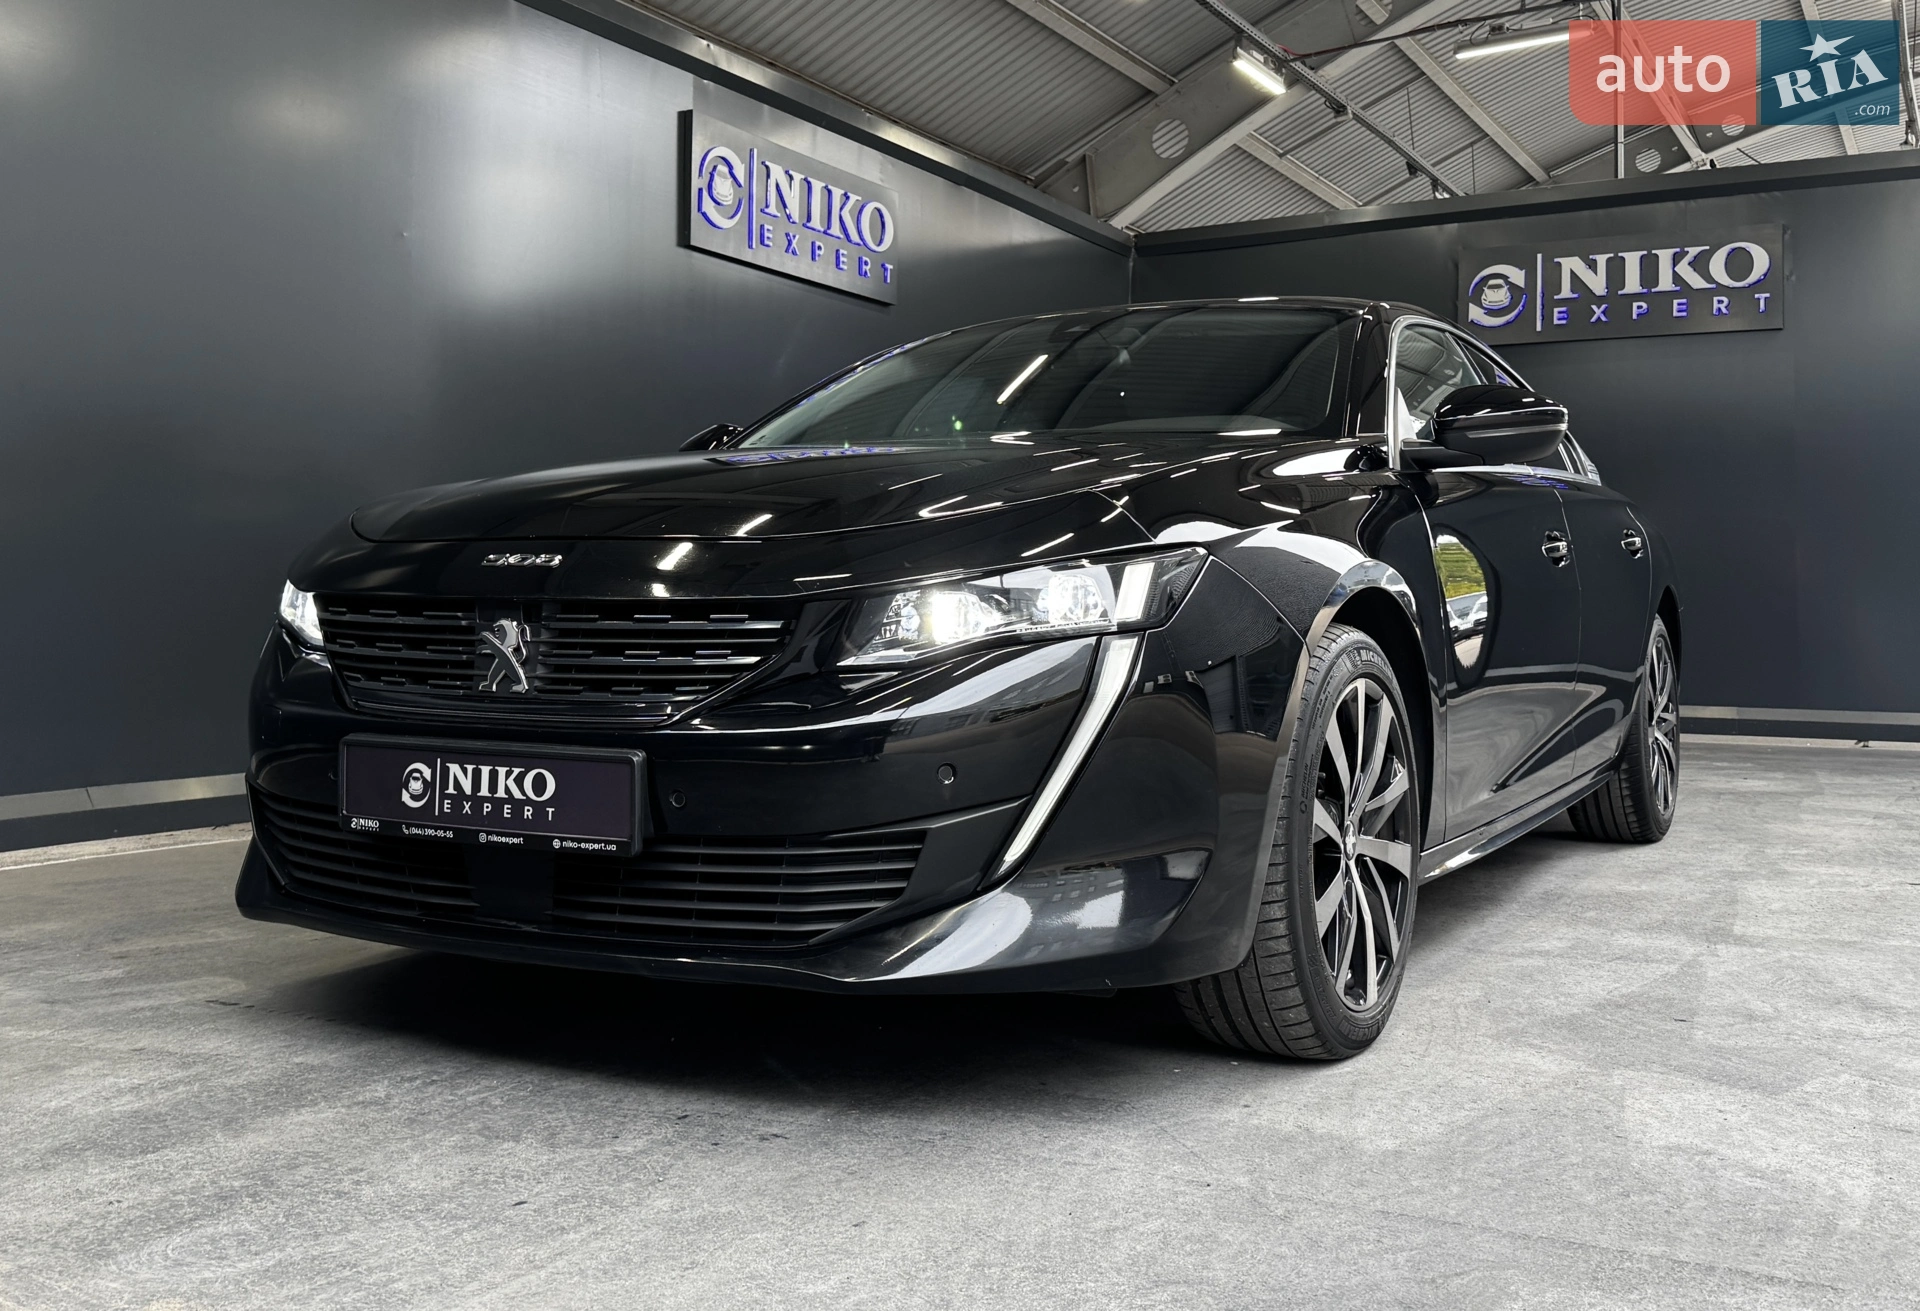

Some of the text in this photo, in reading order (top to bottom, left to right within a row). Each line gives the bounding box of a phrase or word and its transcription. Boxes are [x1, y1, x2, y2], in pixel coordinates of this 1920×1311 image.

[760, 161, 894, 253] NIKO
[760, 223, 894, 284] EXPERT
[1553, 241, 1771, 299] NIKO
[1553, 293, 1771, 325] EXPERT
[445, 763, 556, 801] NIKO
[360, 818, 380, 828] NIKO
[443, 800, 555, 821] EXPERT
[488, 834, 524, 845] nikoexpert
[562, 839, 617, 851] niko-expert.ua
